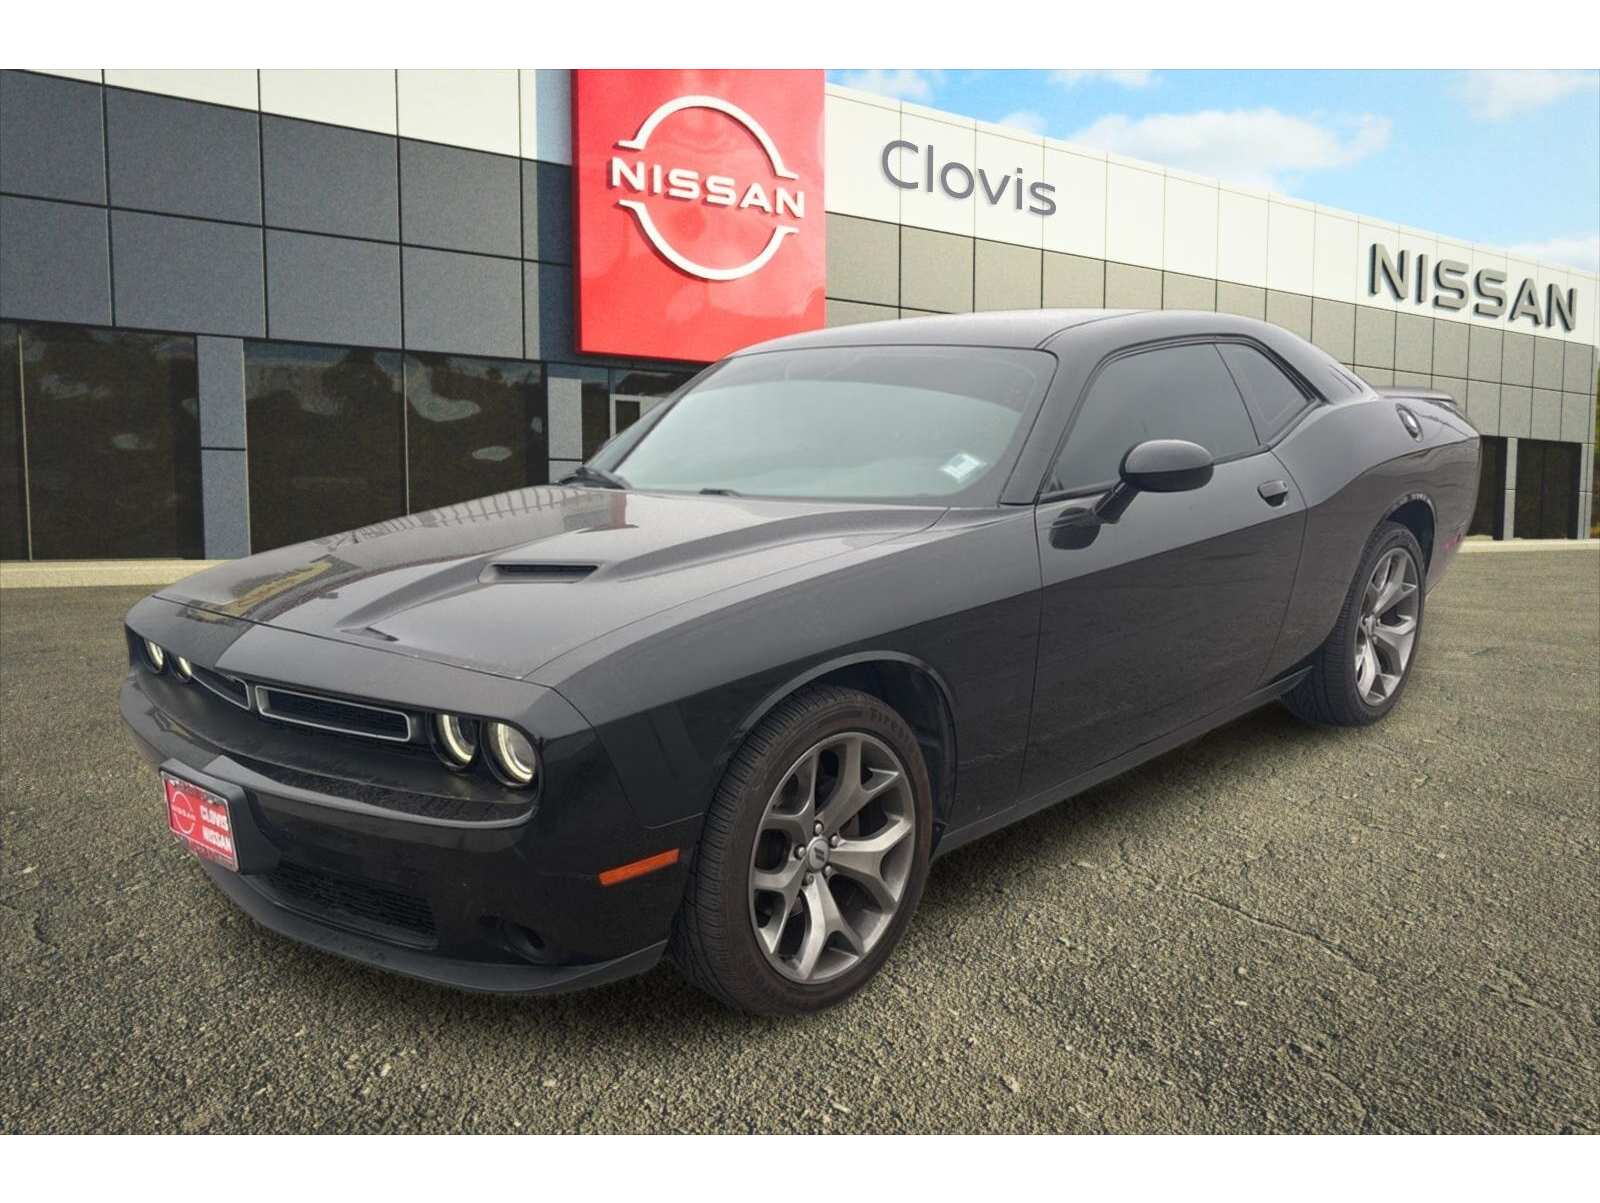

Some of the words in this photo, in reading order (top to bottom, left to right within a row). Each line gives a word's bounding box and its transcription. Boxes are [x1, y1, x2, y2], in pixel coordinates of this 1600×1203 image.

[609, 156, 804, 218] NISSAN
[882, 140, 1057, 216] Clovis
[1369, 243, 1578, 332] NISSAN
